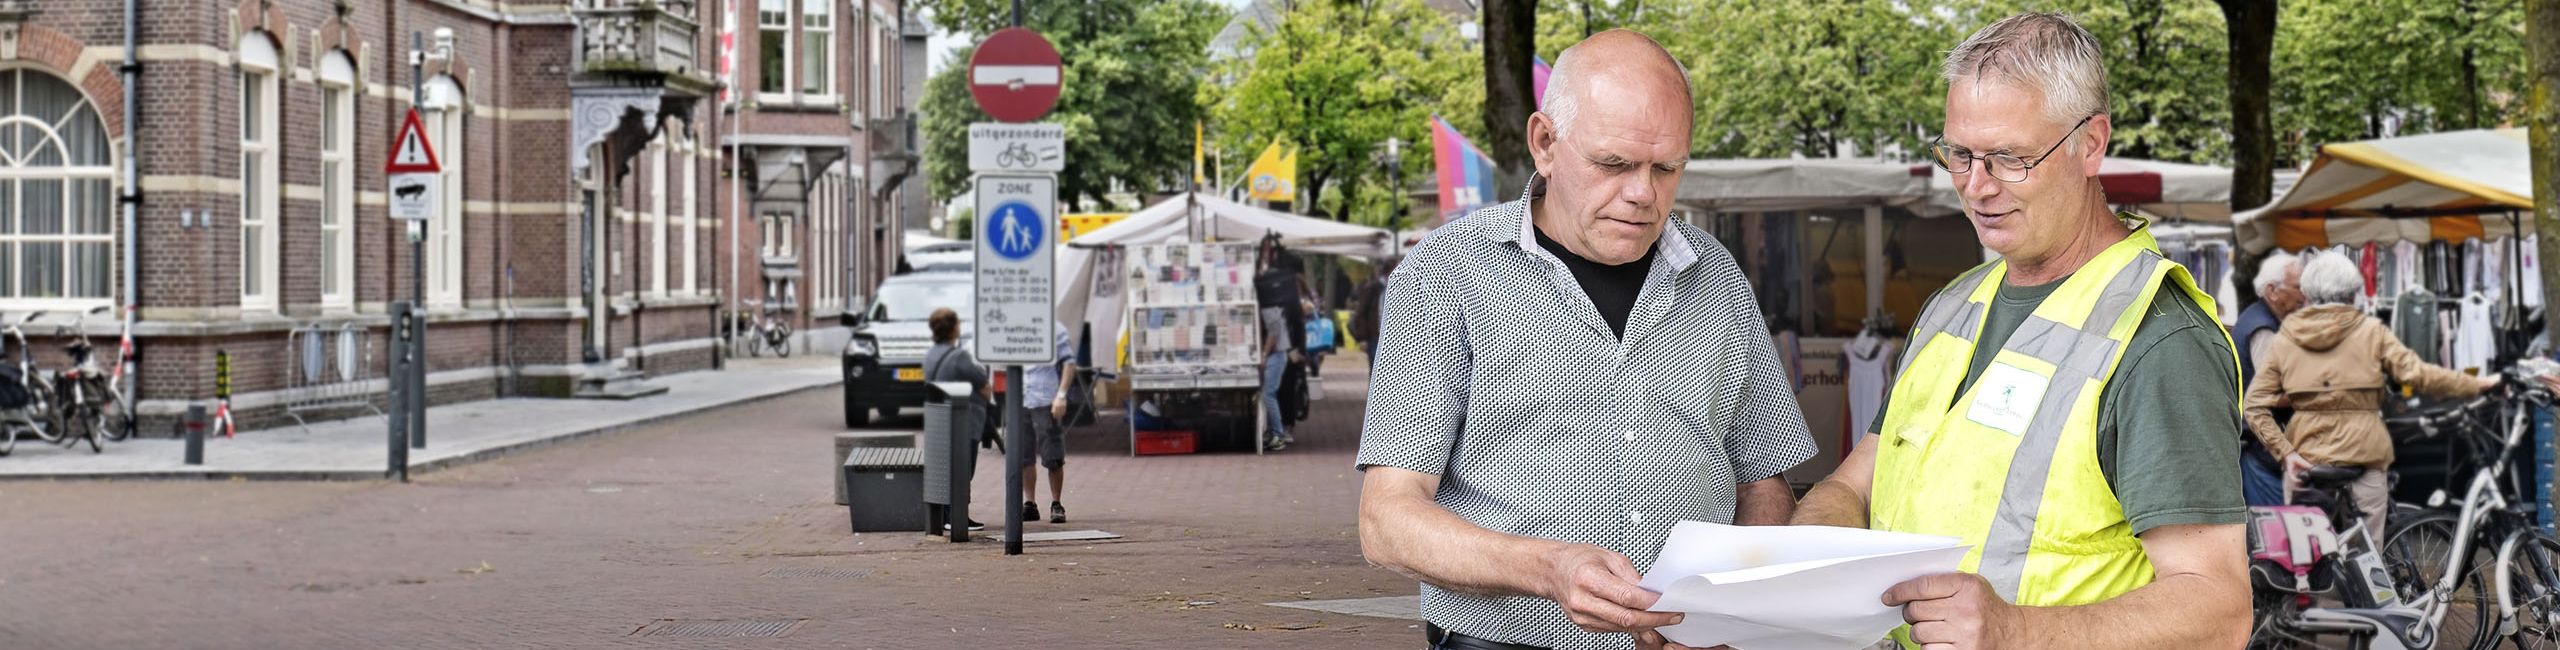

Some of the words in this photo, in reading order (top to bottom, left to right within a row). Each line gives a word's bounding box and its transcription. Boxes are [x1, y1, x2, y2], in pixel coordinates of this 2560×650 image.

[972, 128, 1062, 141] uitgezonderd
[997, 183, 1033, 194] ZONE
[1006, 336, 1043, 344] houders
[992, 345, 1043, 354] toegestaan
